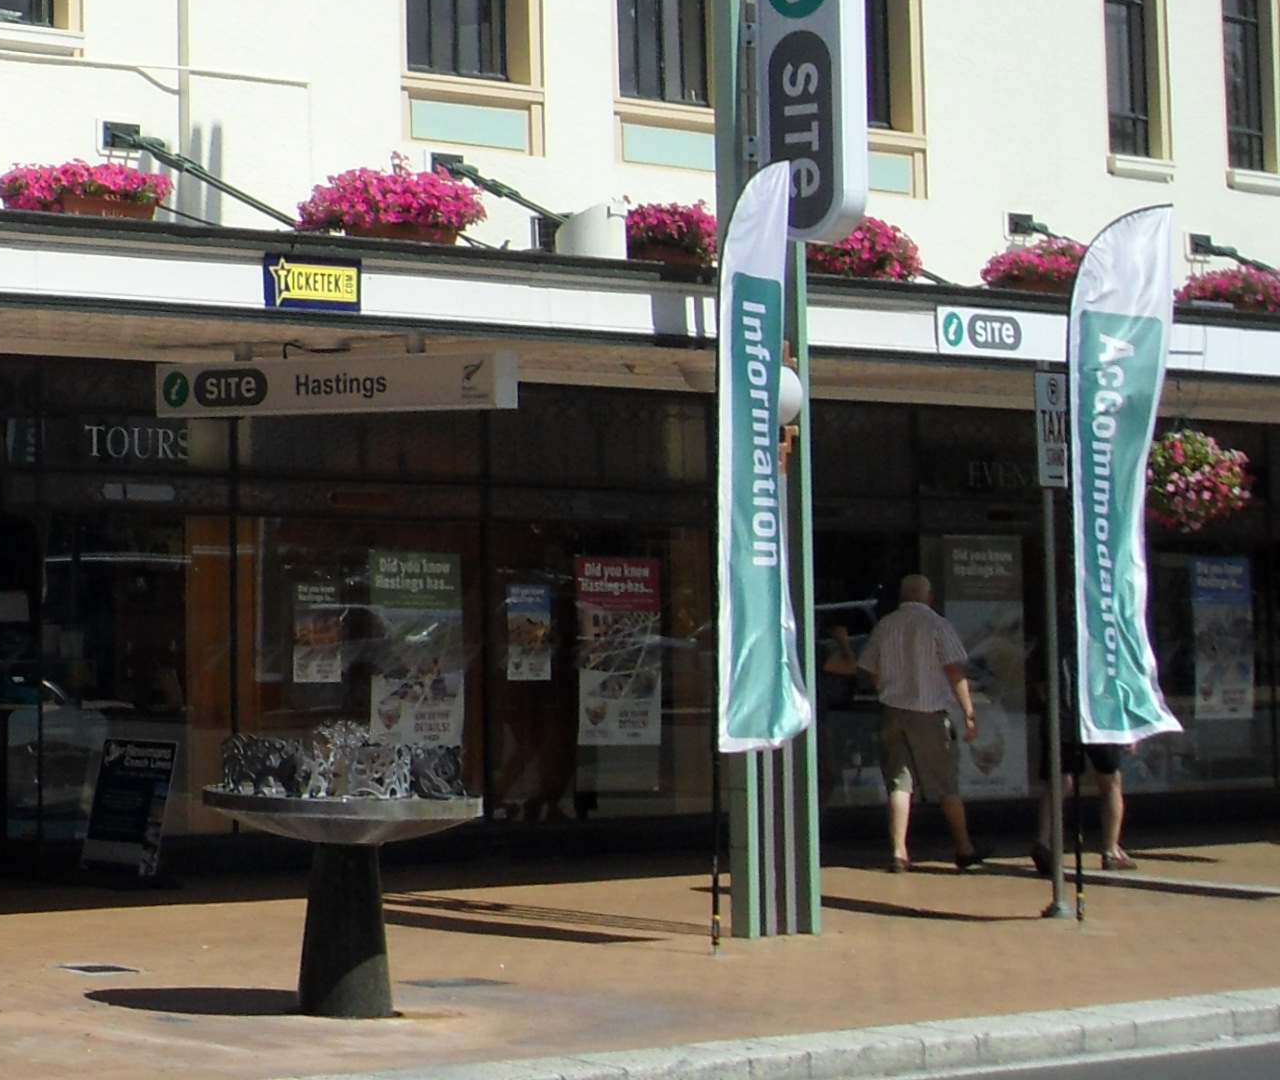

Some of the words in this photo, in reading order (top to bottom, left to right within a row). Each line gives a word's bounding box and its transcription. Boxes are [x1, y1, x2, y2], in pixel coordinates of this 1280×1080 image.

[277, 269, 342, 293] TICKETEK
[295, 372, 388, 399] Hastings
[742, 300, 779, 567] Information
[1040, 410, 1067, 443] TAX
[84, 423, 192, 460] TOURS
[379, 556, 398, 573] Did
[399, 560, 421, 578] you
[422, 559, 451, 574] know
[584, 562, 601, 577] Did
[602, 566, 623, 583] you
[623, 563, 650, 578] know
[375, 575, 425, 593] Hastings
[580, 578, 626, 596] Hastings
